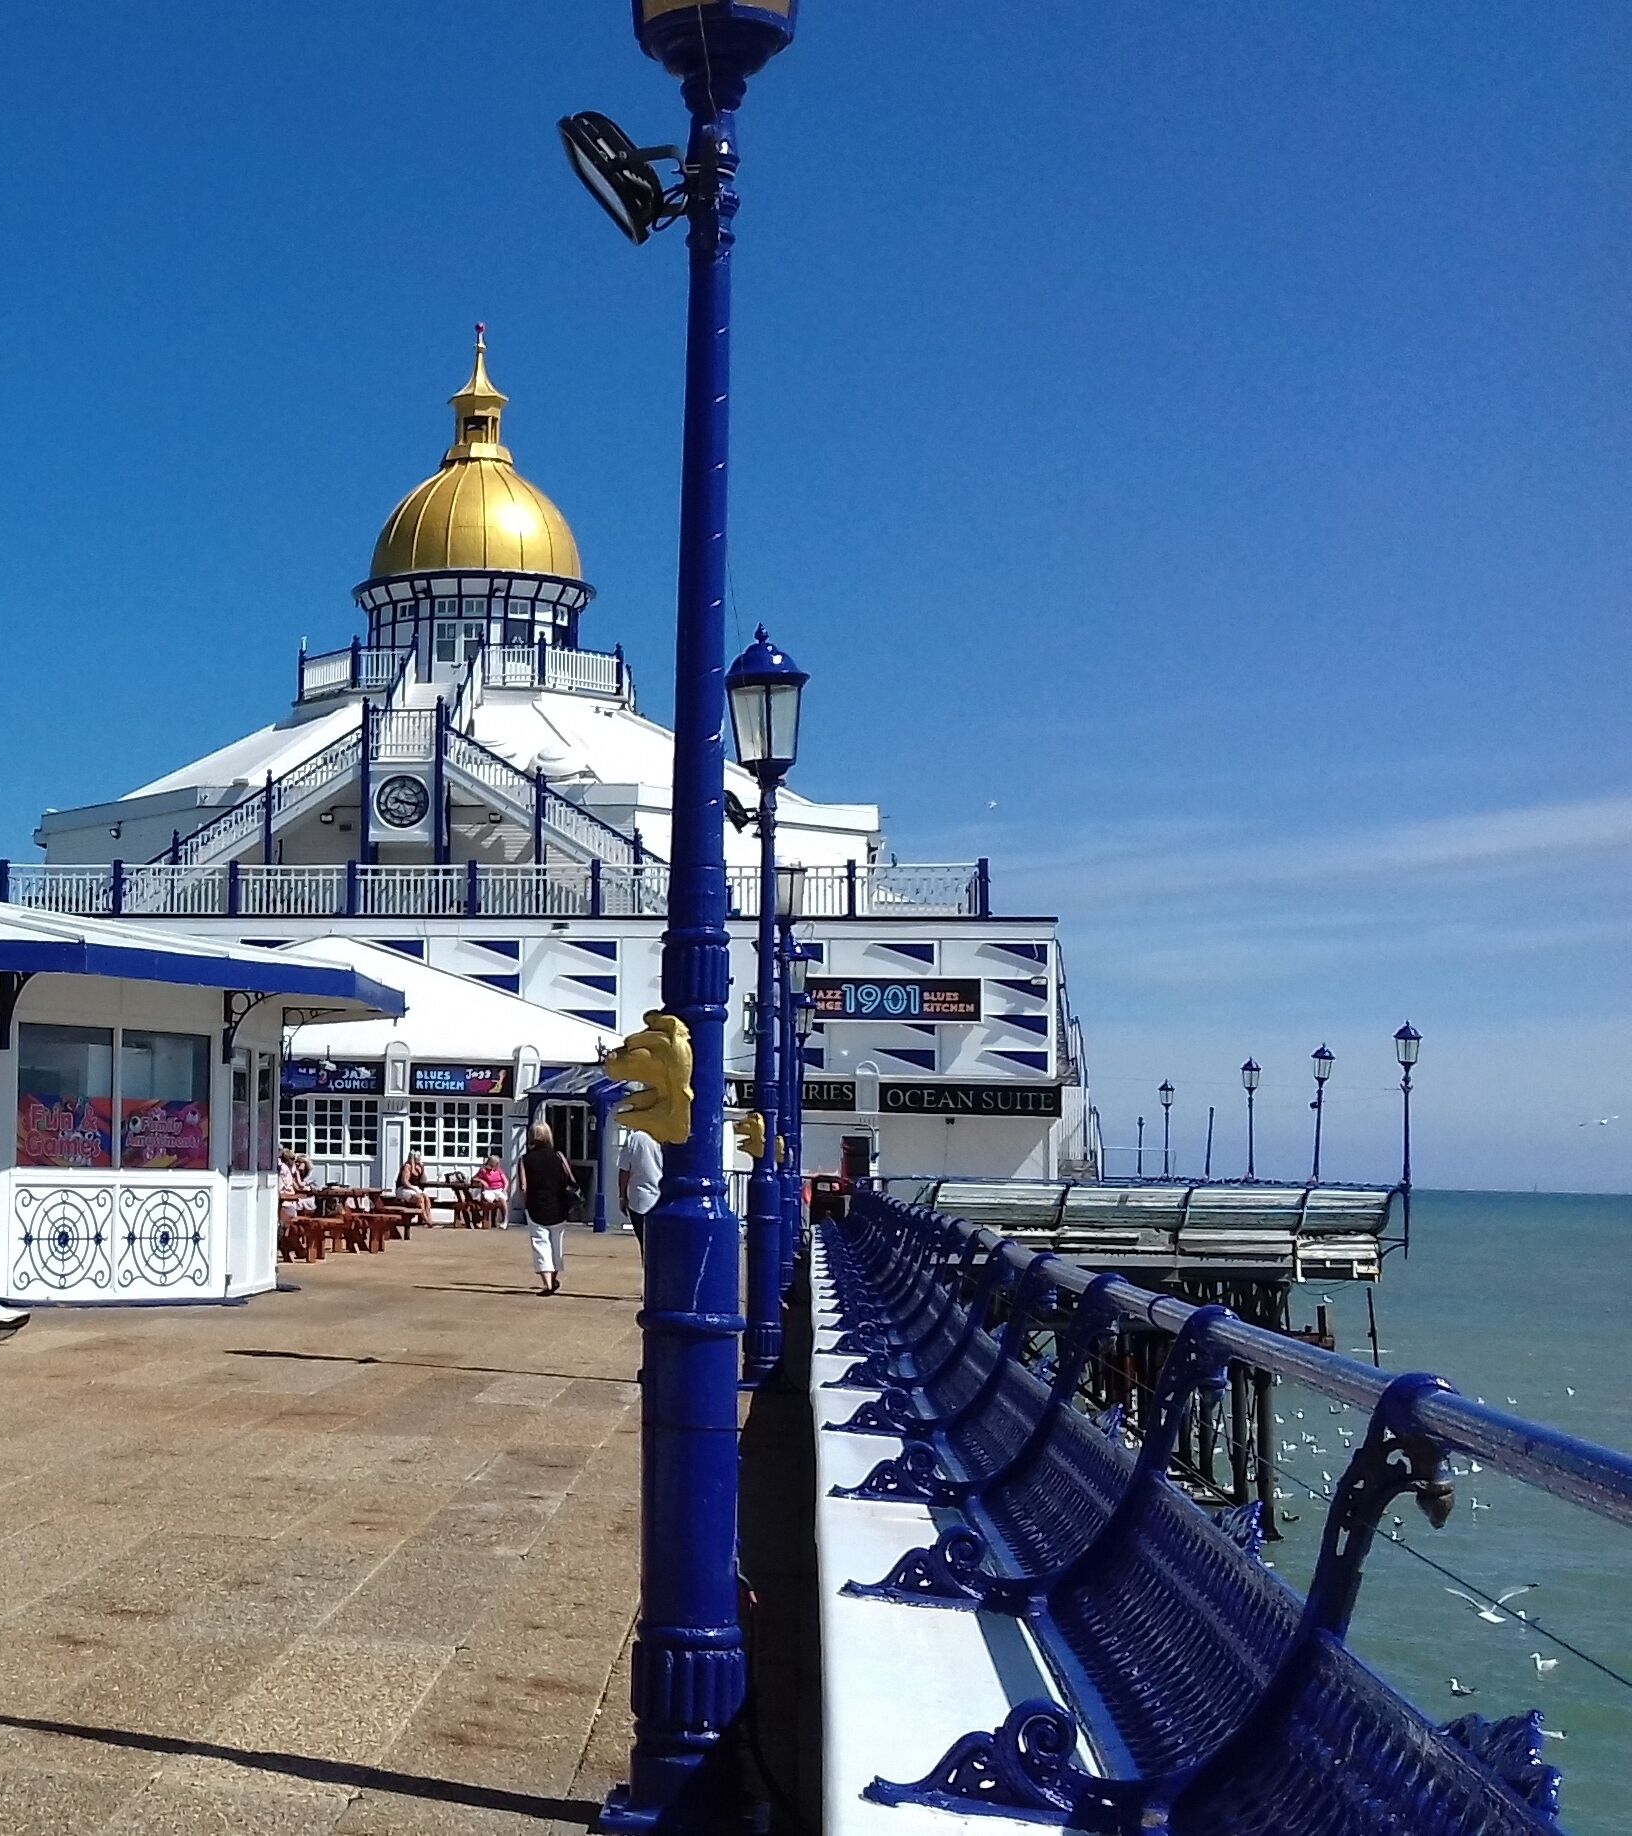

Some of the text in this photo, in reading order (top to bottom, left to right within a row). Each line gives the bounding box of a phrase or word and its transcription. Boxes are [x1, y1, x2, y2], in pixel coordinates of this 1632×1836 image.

[811, 989, 842, 1000] JAZZ
[841, 984, 920, 1014] 1901
[923, 991, 960, 1001] BLUES
[923, 1003, 975, 1013] KITCHEN
[415, 1070, 451, 1080] BLUES
[415, 1080, 465, 1091] KITCHEN
[743, 1083, 854, 1102] EIRIES
[886, 1088, 1055, 1112] OCEAN SUITE
[29, 1104, 74, 1132] Fun
[142, 1116, 183, 1136] Family
[25, 1130, 102, 1158] Games
